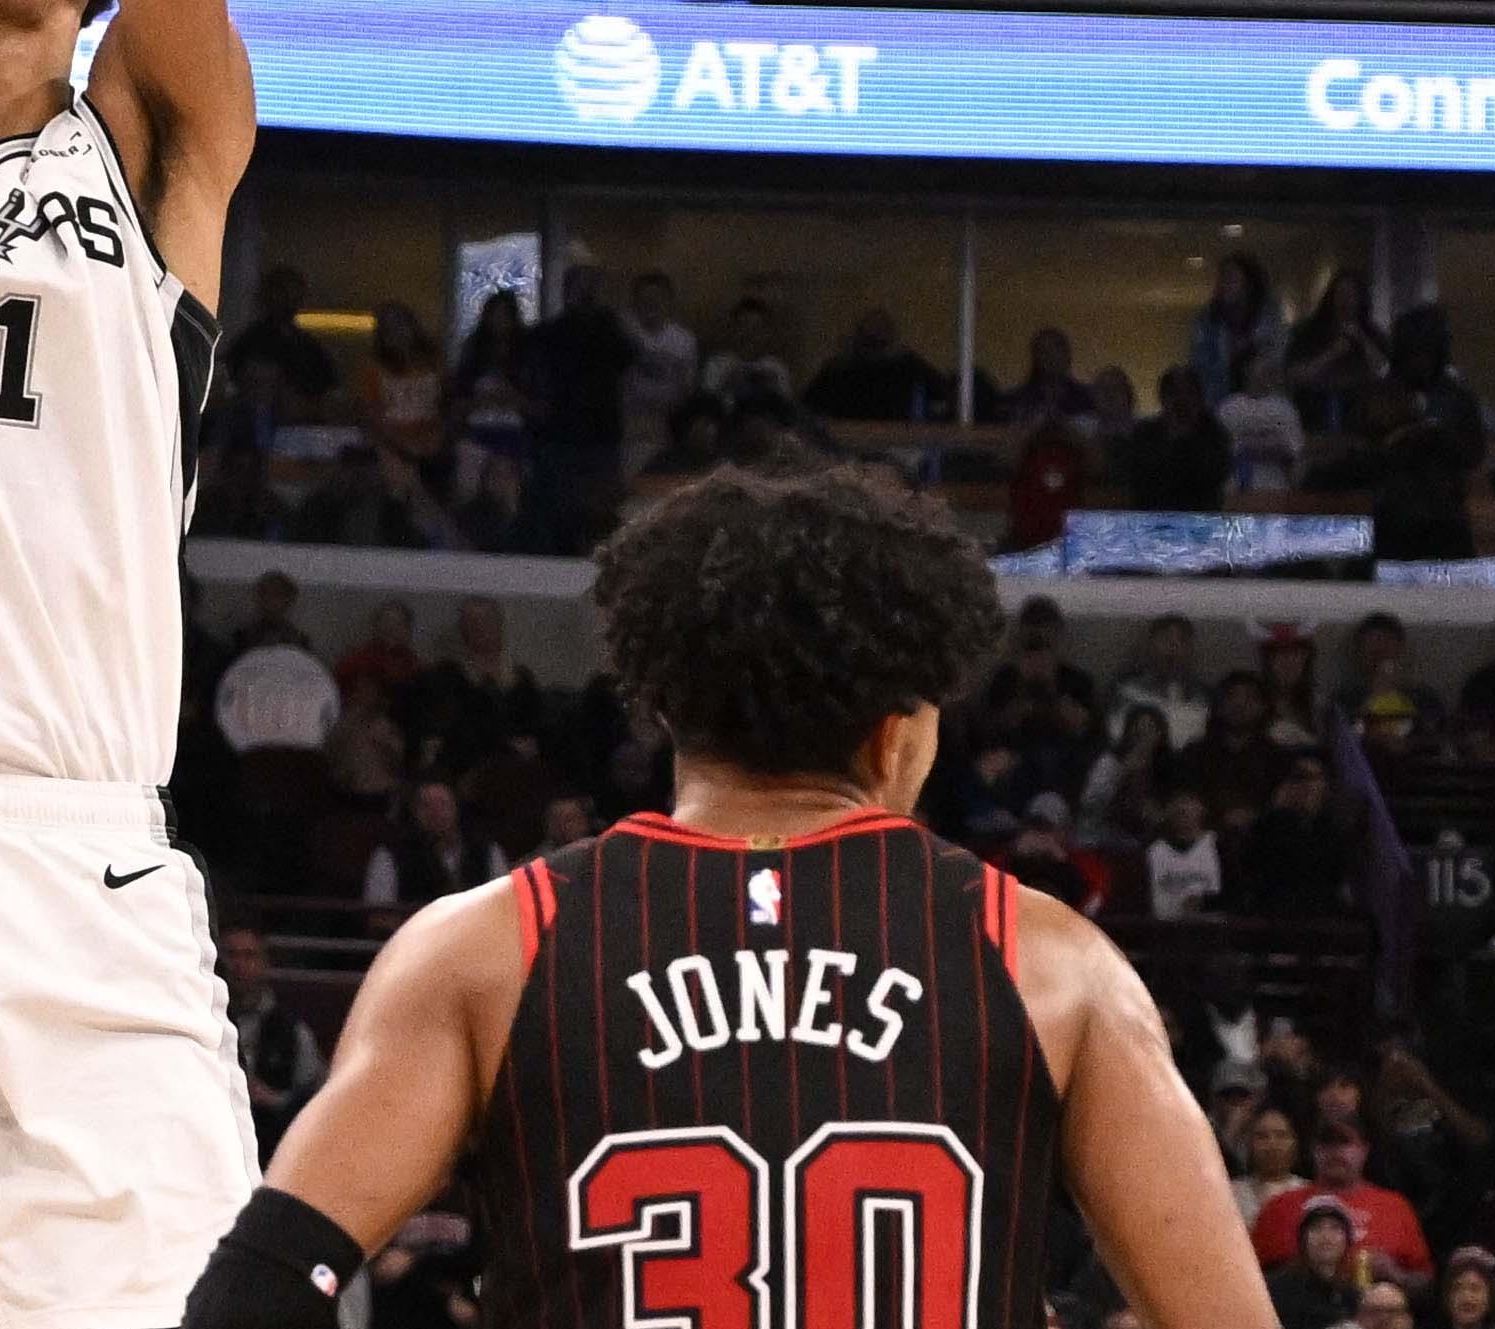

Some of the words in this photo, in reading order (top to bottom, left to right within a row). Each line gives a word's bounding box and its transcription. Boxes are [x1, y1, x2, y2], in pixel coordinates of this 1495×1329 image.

[673, 39, 879, 118] AT&T
[1427, 856, 1492, 908] 115
[626, 948, 924, 1070] JONES
